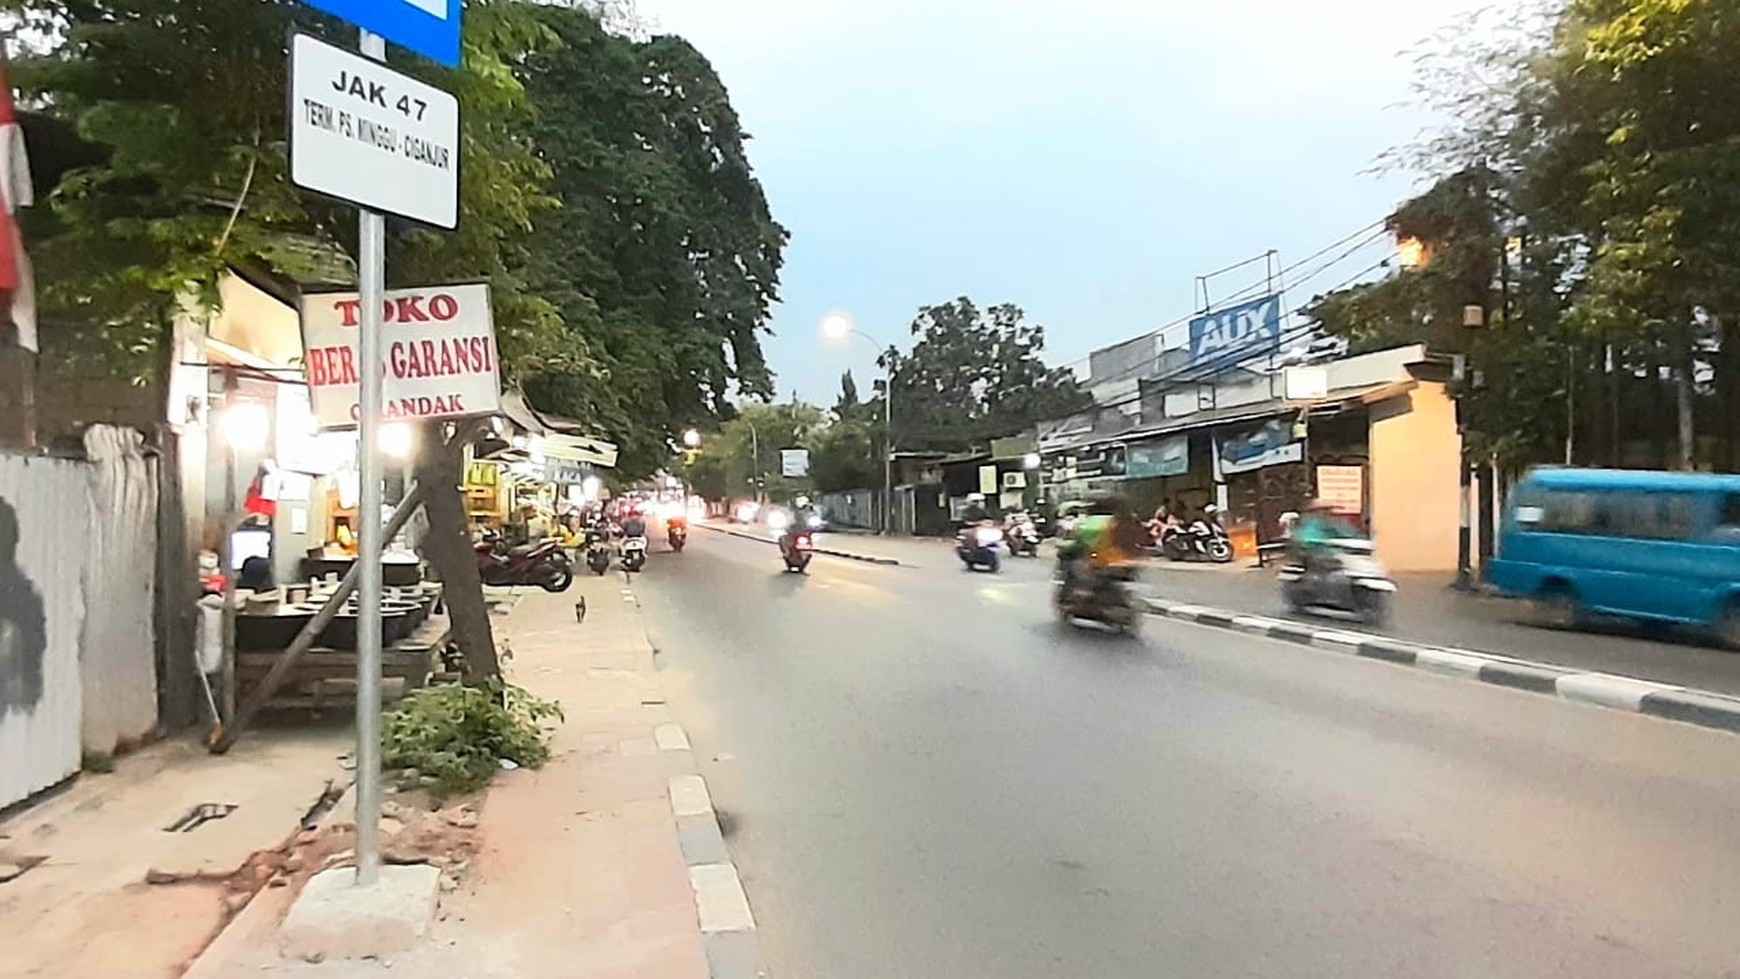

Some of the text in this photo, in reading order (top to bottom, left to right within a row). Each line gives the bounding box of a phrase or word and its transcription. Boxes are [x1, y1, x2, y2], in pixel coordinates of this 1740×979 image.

[331, 71, 427, 121] JAK 47
[358, 118, 397, 152] MINGGU
[404, 135, 449, 171] CIGANJUR
[1197, 301, 1273, 355] AUX
[310, 336, 492, 386] BER GARANSI
[350, 394, 465, 421] CANDAK
